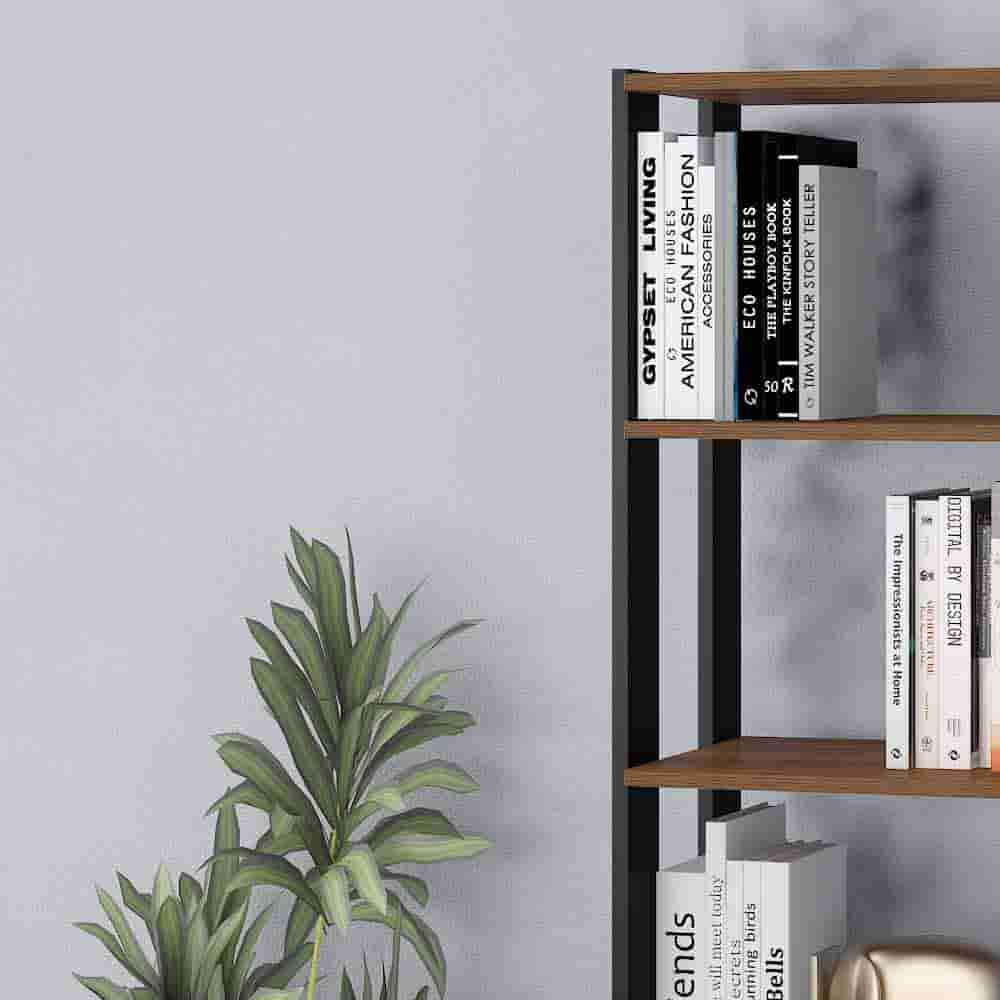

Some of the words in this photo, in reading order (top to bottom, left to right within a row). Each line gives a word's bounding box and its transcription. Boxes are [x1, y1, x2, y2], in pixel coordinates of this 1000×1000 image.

[643, 156, 657, 252] LIVING
[680, 153, 695, 256] FASHION
[766, 202, 777, 243] BOOK
[782, 197, 793, 235] BOOK
[803, 183, 816, 234] TELLER
[665, 208, 677, 265] HOUSES
[742, 206, 756, 280] HOUSES
[701, 213, 713, 329] ACCESSORIES
[766, 246, 777, 309] PLAYBOY
[782, 238, 793, 295] KINFOLK
[803, 239, 816, 289] STORY
[666, 276, 677, 304] ECO
[743, 293, 756, 330] ECO
[782, 297, 793, 324] THE
[643, 272, 657, 385] GYPSET
[680, 265, 695, 390] AMERICAN
[766, 310, 777, 340] THE
[803, 293, 816, 358] WALKER
[803, 363, 816, 390] TIM
[892, 533, 904, 556] The
[947, 496, 963, 555] DIGITAL
[947, 565, 963, 582] BY
[890, 559, 904, 650] Impressionists
[947, 592, 963, 647] DESIGN
[892, 654, 903, 668] at
[892, 670, 904, 706] Home
[709, 874, 725, 918] today
[709, 922, 723, 961] meet
[744, 903, 757, 942] birds
[708, 963, 723, 992] will
